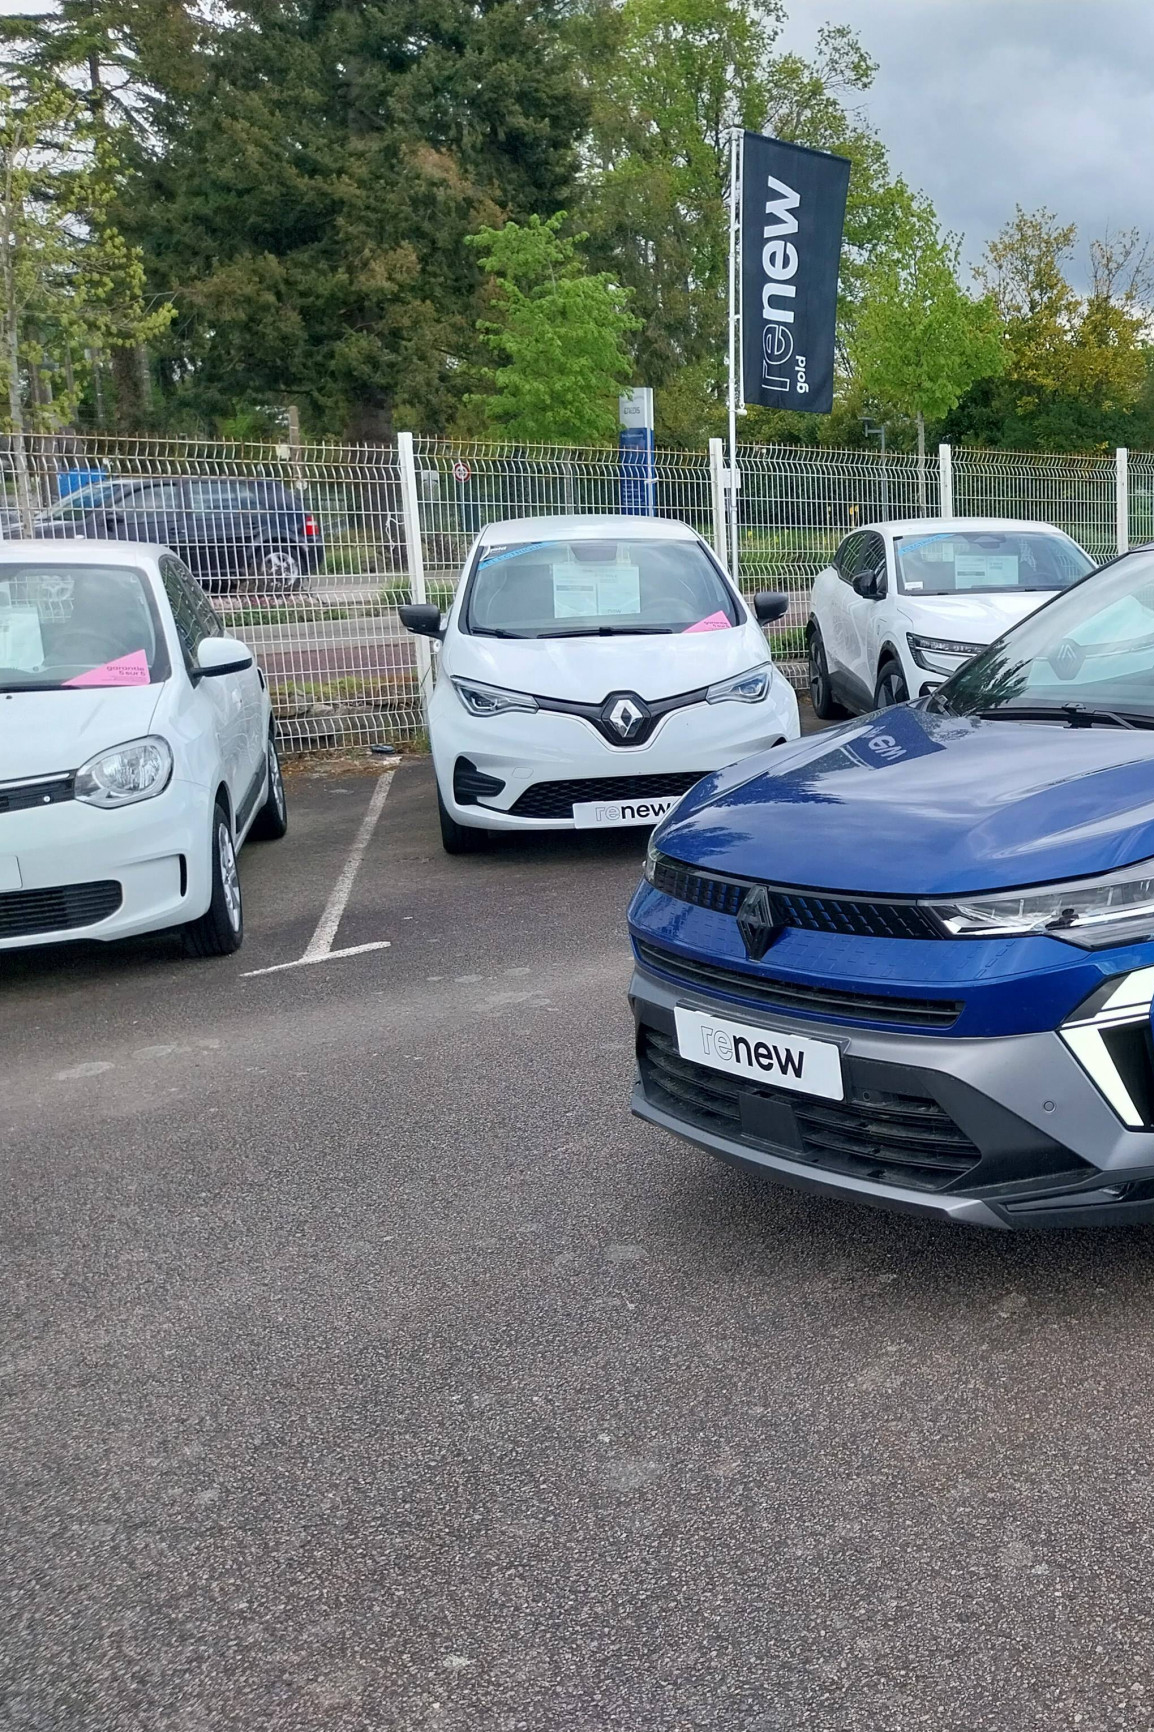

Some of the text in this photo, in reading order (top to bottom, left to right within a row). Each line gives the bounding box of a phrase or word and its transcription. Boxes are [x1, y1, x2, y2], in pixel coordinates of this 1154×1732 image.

[762, 175, 800, 392] renew
[795, 355, 809, 394] gold
[595, 802, 672, 821] renew
[701, 1026, 804, 1079] renew
